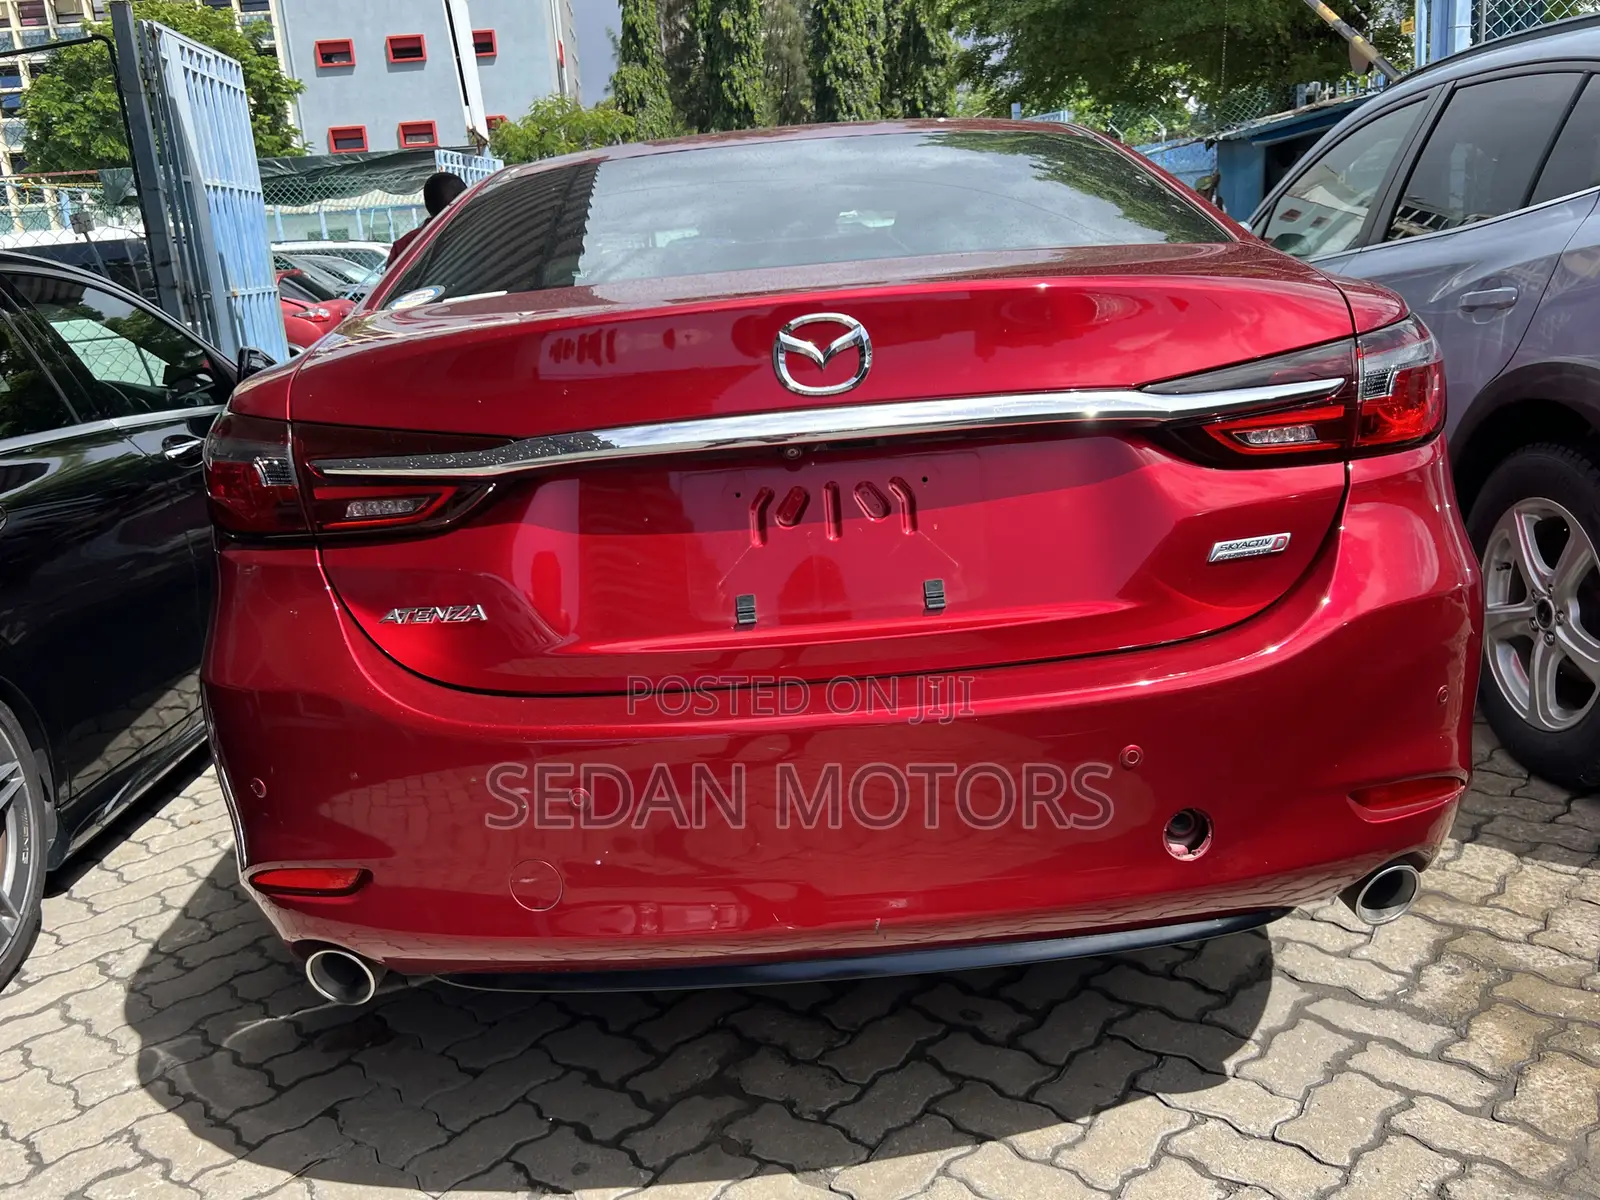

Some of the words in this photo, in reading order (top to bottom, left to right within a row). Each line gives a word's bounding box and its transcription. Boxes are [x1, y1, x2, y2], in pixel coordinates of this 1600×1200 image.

[1219, 537, 1272, 552] SKYACTIV
[1271, 535, 1288, 550] D
[378, 604, 488, 624] ATENZA
